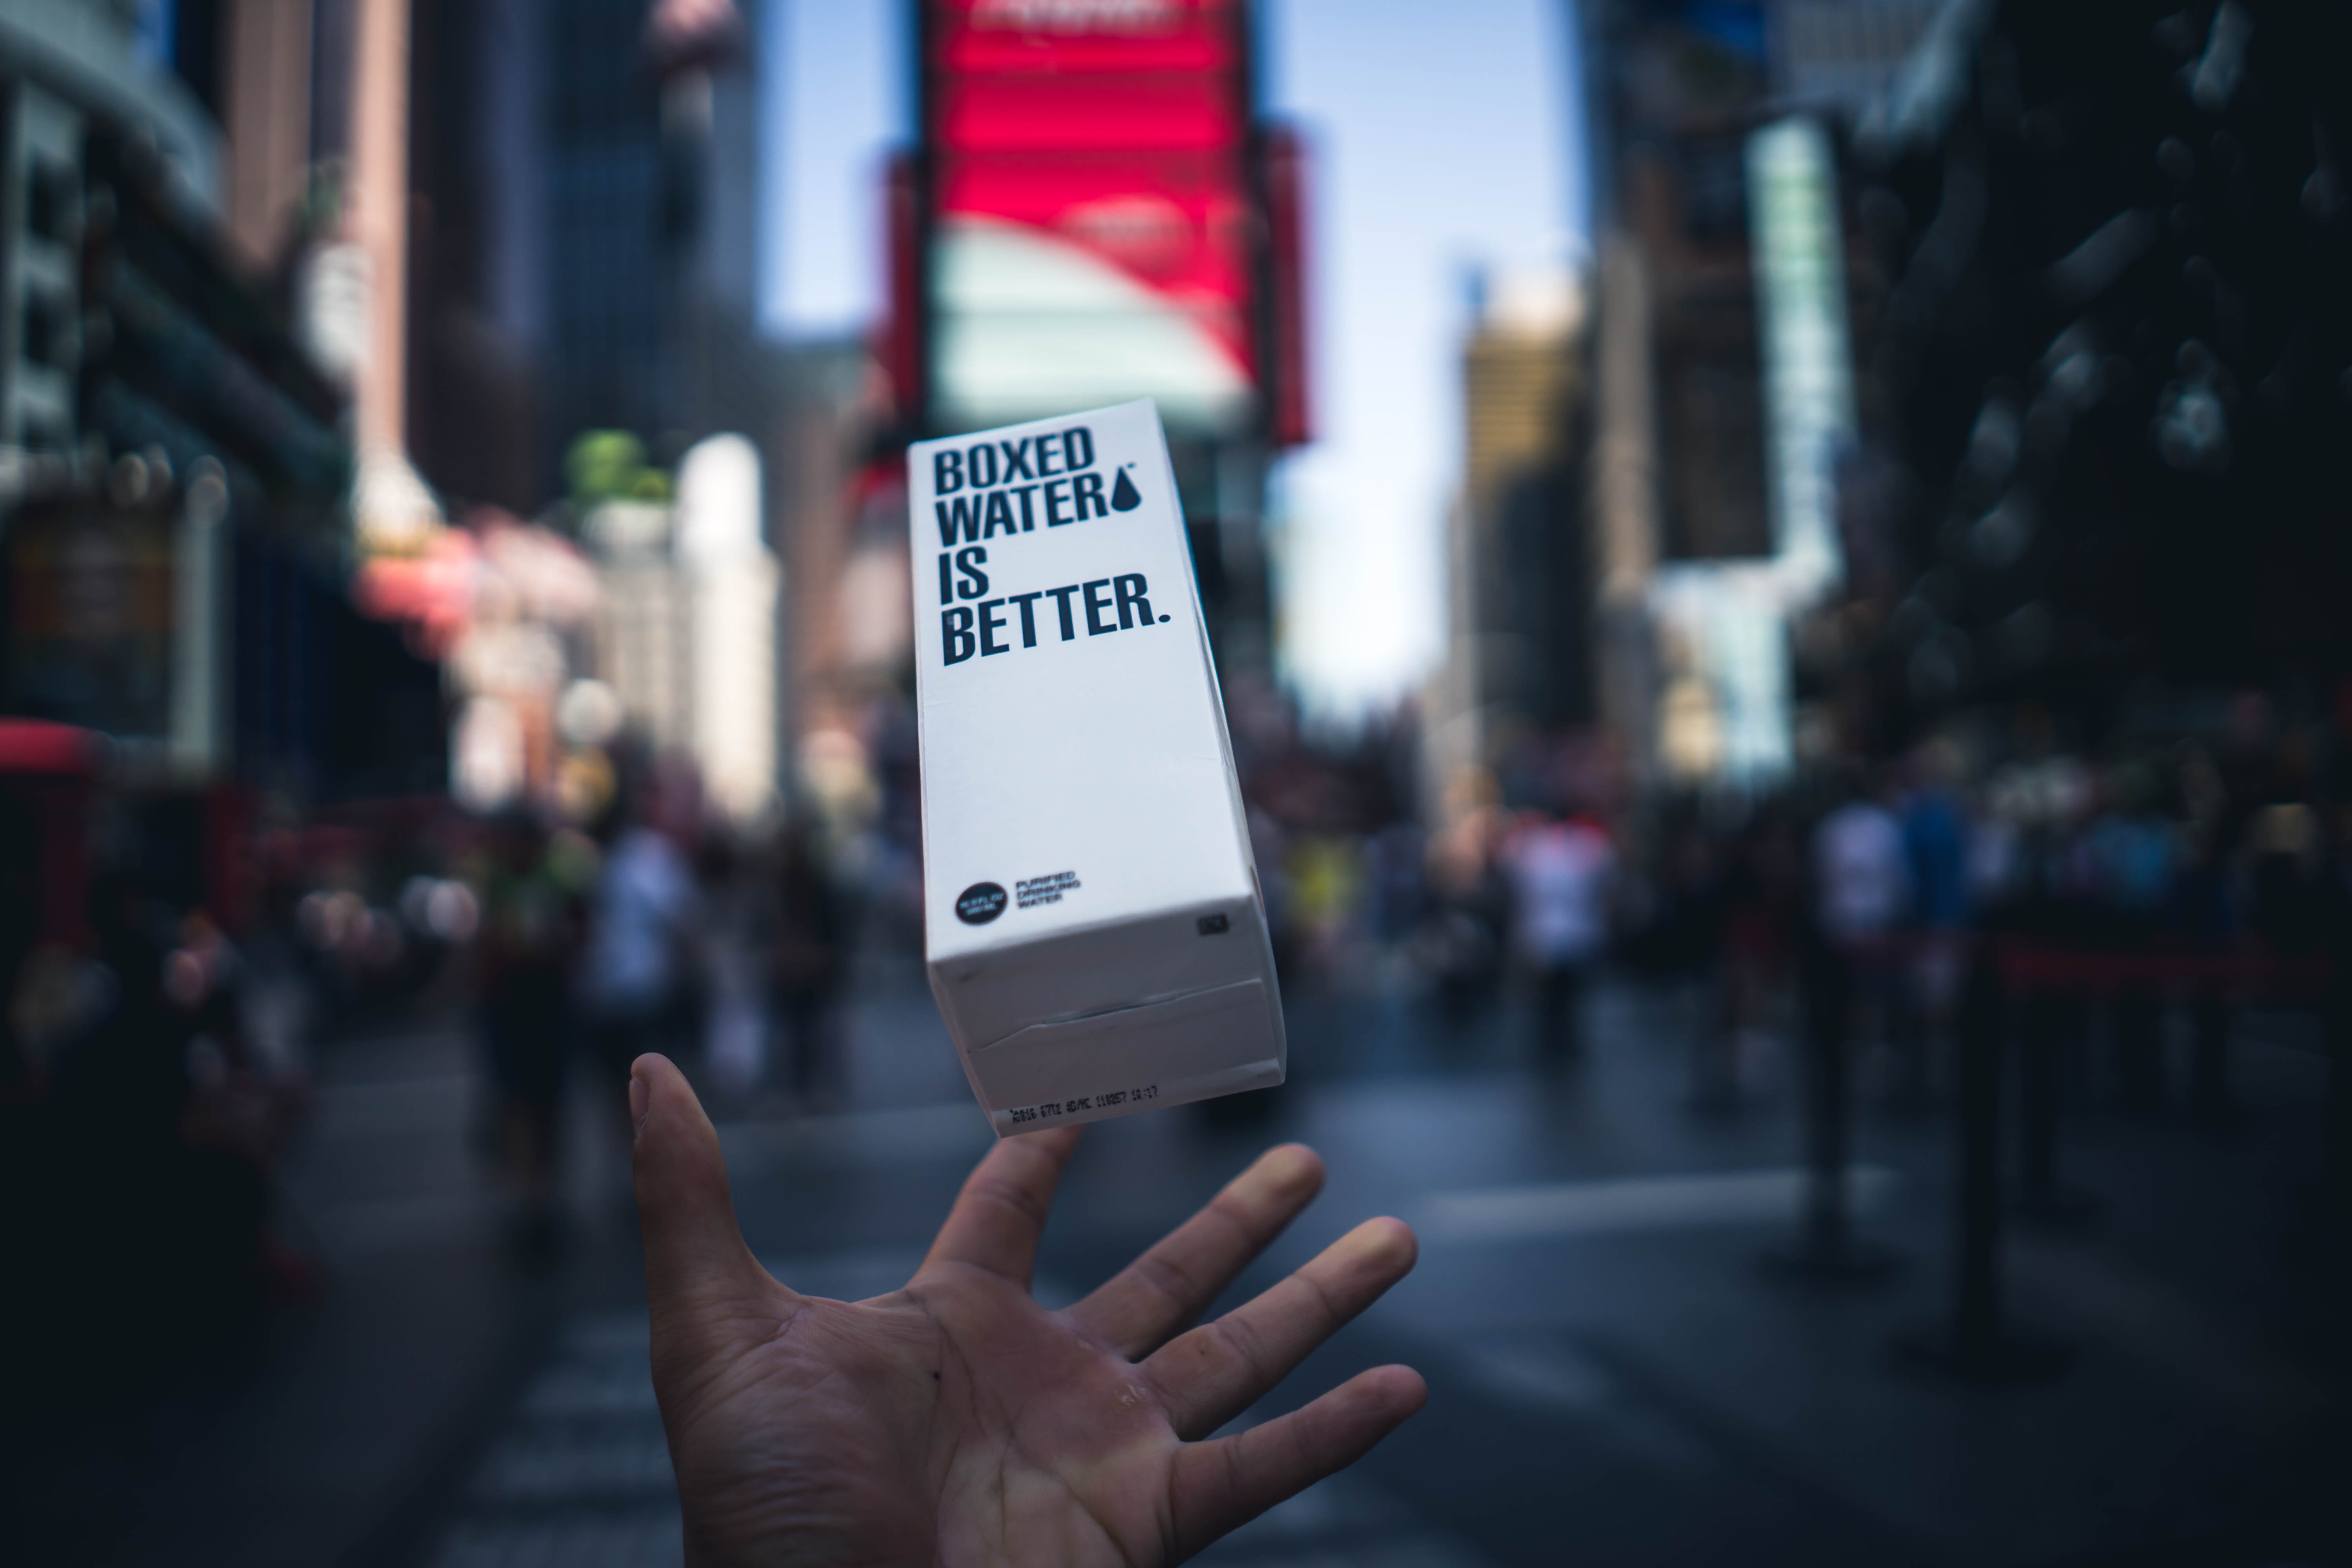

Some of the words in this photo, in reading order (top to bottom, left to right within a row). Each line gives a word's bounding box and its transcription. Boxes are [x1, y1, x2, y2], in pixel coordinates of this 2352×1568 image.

[933, 426, 1096, 496] BOXED
[934, 472, 1109, 548] WATER
[938, 546, 989, 606] IS
[941, 572, 1171, 666] BETTER.
[1016, 870, 1076, 888] PURIFIED
[1016, 879, 1082, 898] DRINKING
[1017, 893, 1063, 910] WATER
